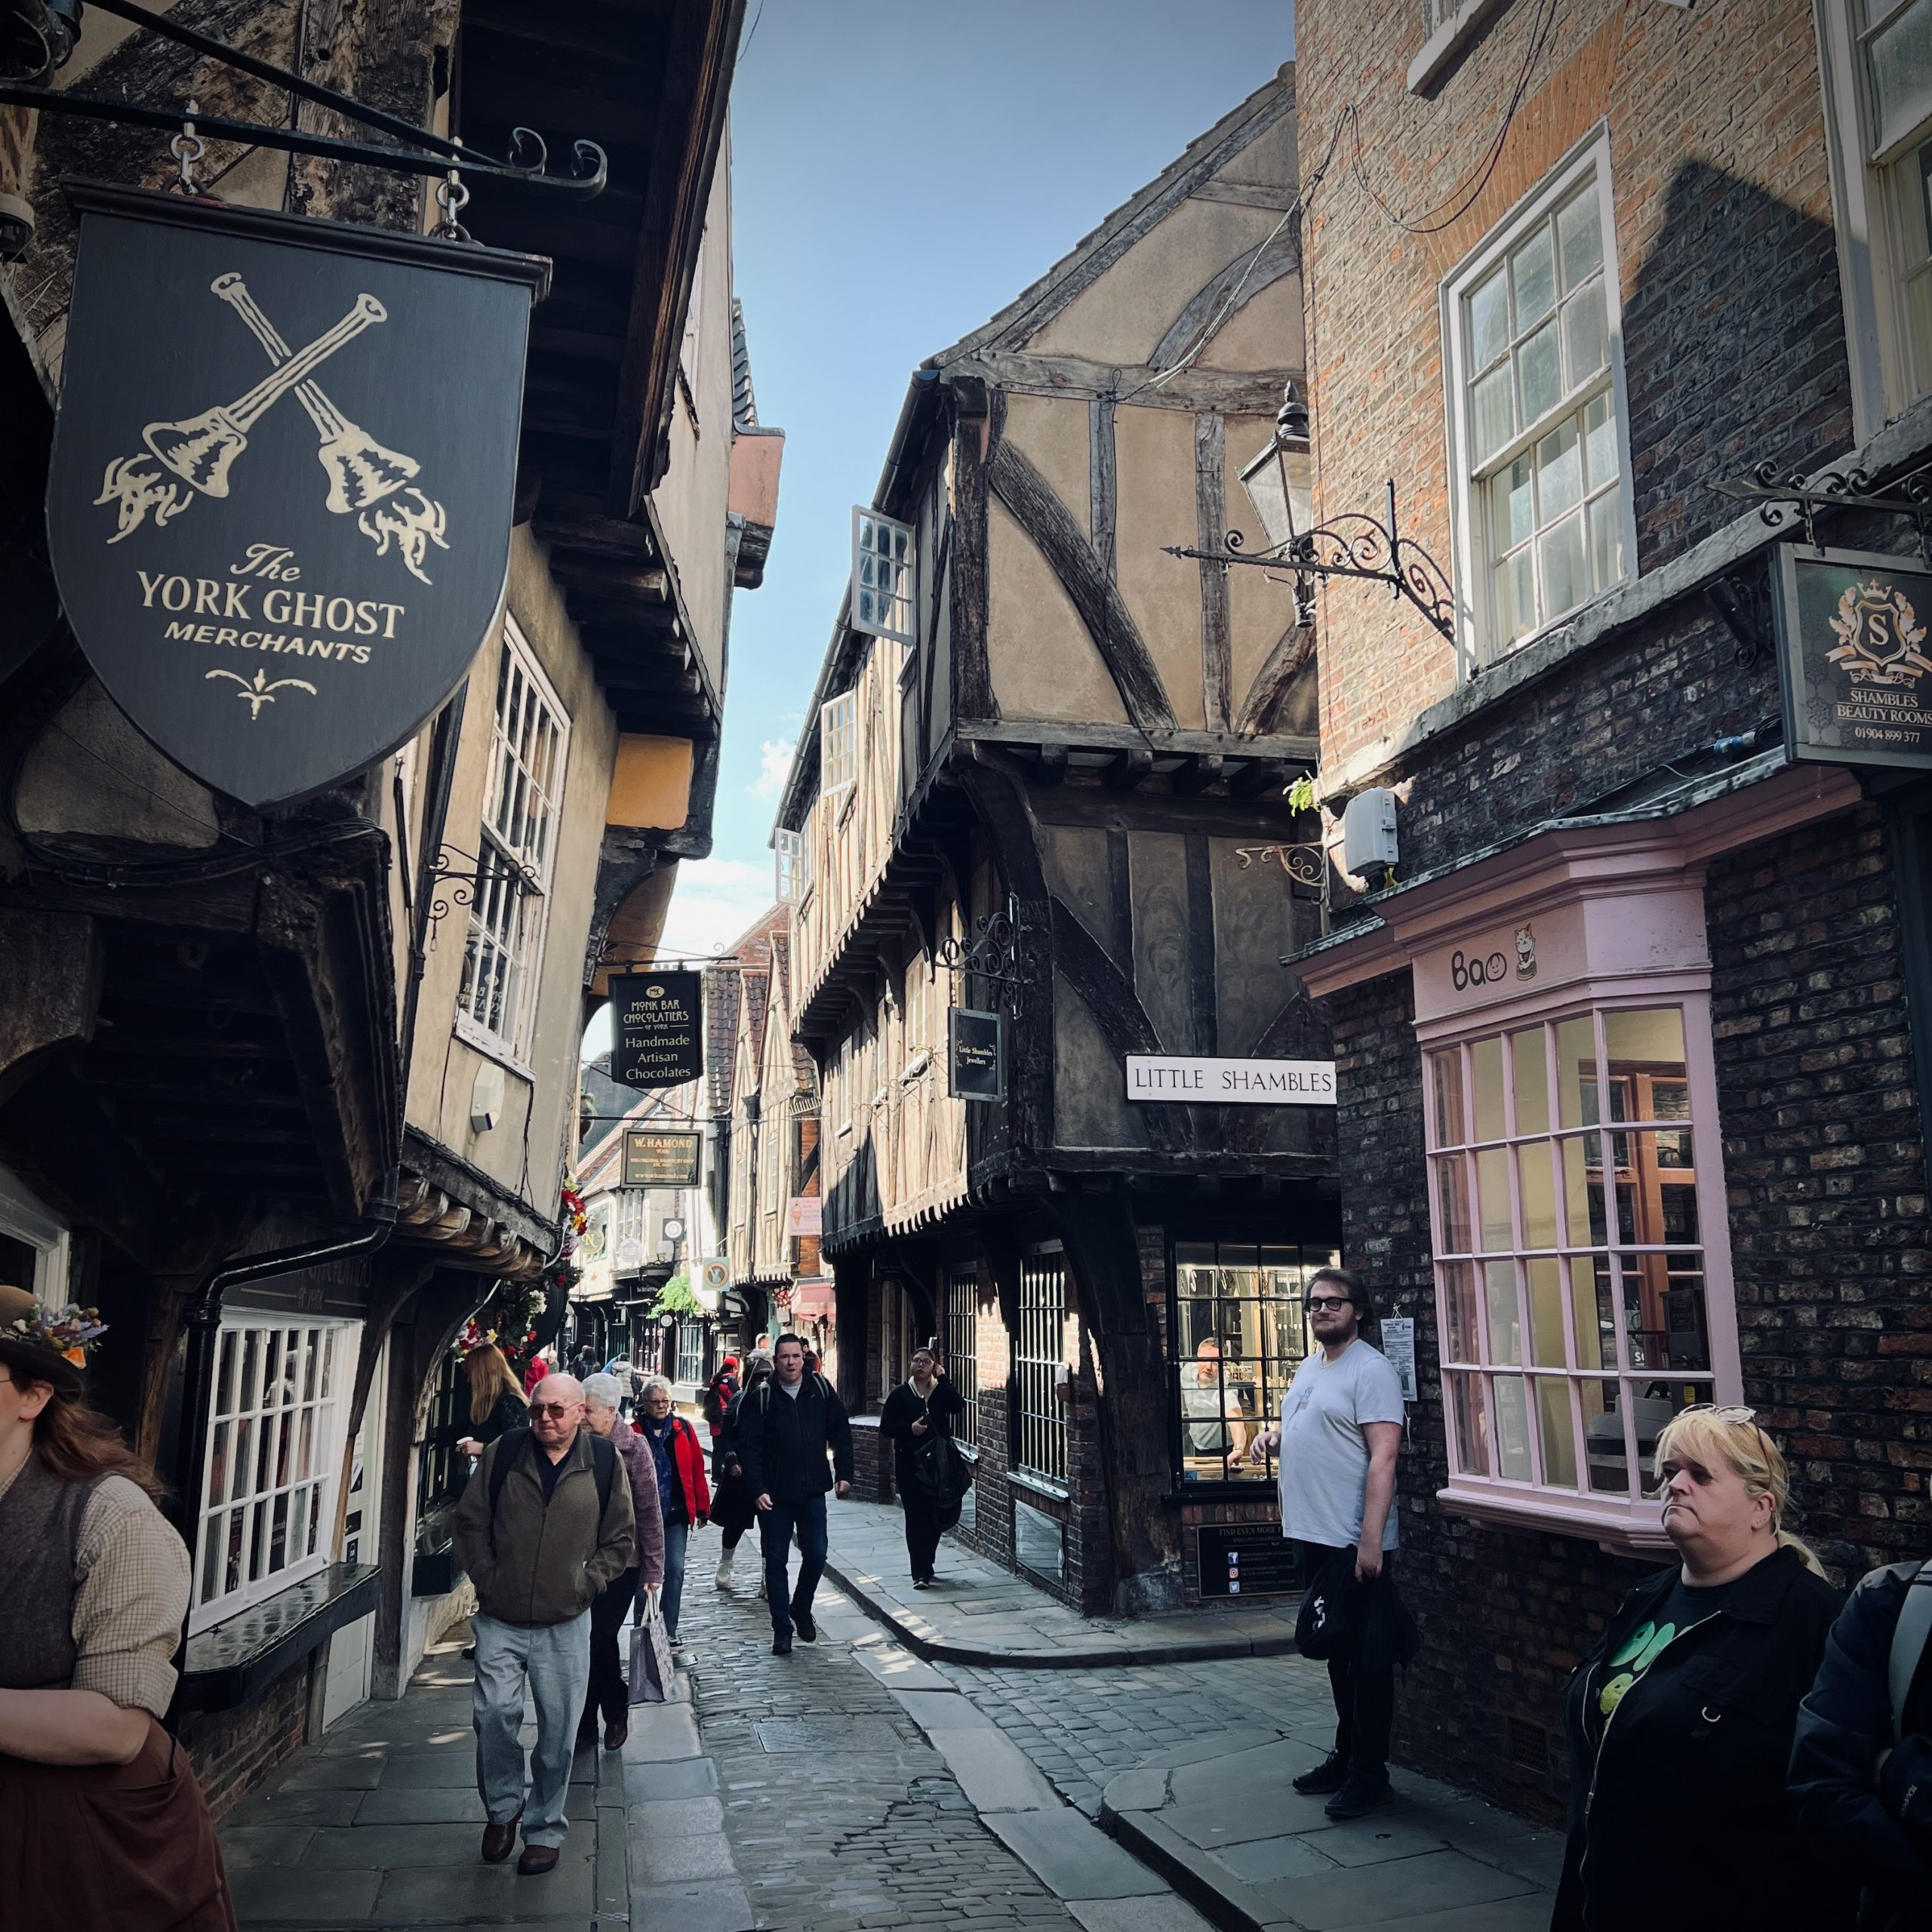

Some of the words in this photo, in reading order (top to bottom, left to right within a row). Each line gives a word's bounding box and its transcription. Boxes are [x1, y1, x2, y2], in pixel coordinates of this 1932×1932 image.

[229, 543, 301, 582] The
[135, 571, 251, 619] YORK
[263, 588, 405, 638] GHOST
[1868, 614, 1889, 646] S
[163, 621, 372, 664] MERCHANTS
[1850, 691, 1918, 708] SHAMBLES
[1837, 704, 1888, 721] BEAUTY
[1890, 709, 1932, 726] ROOMS
[1854, 727, 1883, 740] 01904
[1885, 730, 1903, 742] 899
[1903, 731, 1921, 743] 377
[1451, 950, 1508, 992] Bao
[631, 1001, 658, 1012] MONK
[660, 999, 680, 1011] BAR
[623, 1011, 689, 1024] CHOCOLATIERS
[626, 1034, 690, 1049] Handmade
[637, 1051, 678, 1063] Artisan
[971, 1047, 992, 1056] Shambles
[966, 1056, 986, 1065] Jewellers
[626, 1066, 691, 1080] Chocolates
[1135, 1068, 1204, 1089] LITTLE
[1221, 1070, 1333, 1093] SHAMBLES
[634, 1137, 646, 1148] W.
[647, 1138, 693, 1148] HAMOND
[1219, 1528, 1235, 1537] FIND
[1237, 1527, 1256, 1536] EVEN
[1257, 1525, 1276, 1534] MORE
